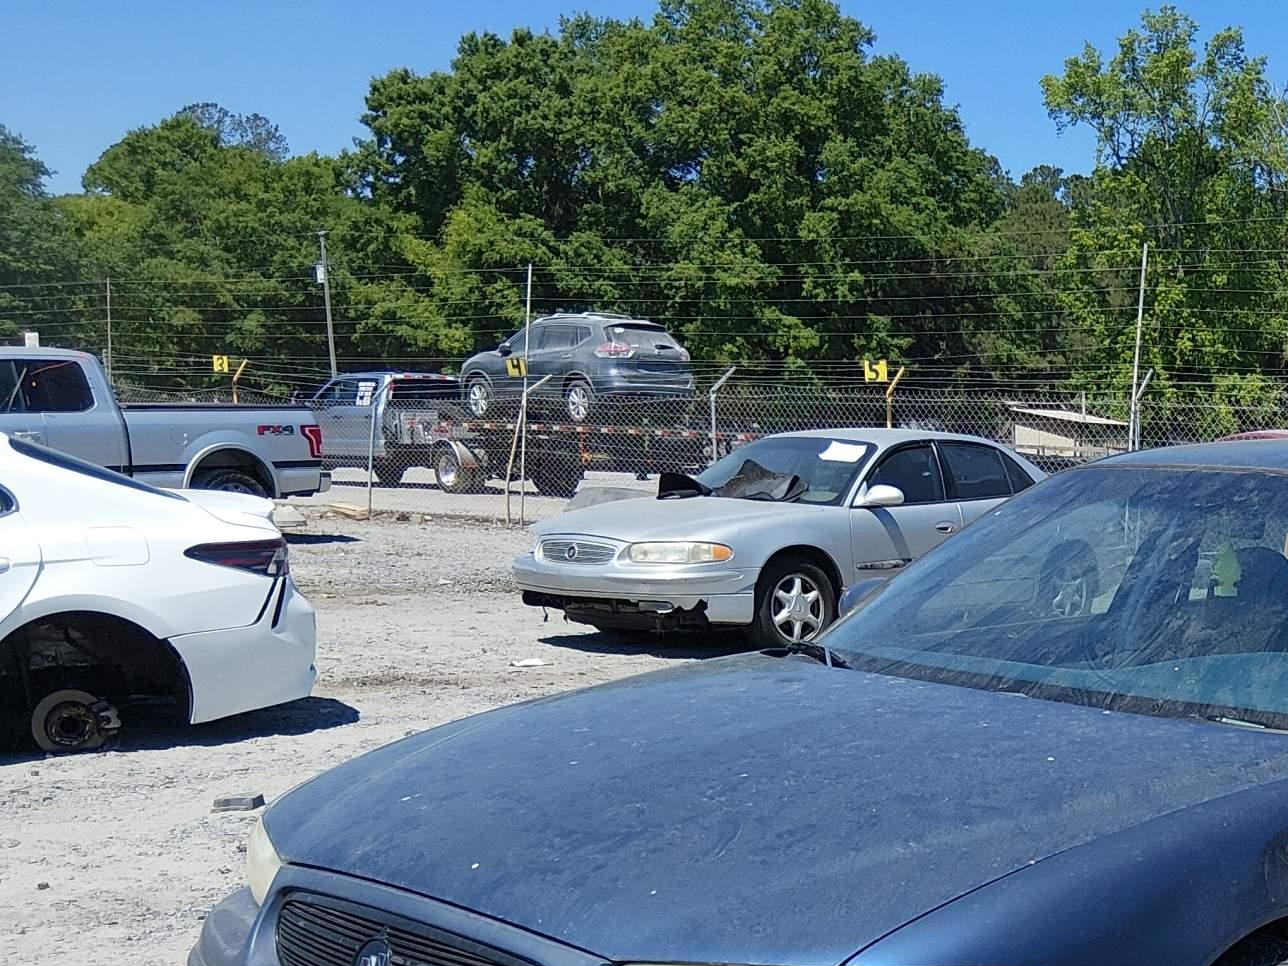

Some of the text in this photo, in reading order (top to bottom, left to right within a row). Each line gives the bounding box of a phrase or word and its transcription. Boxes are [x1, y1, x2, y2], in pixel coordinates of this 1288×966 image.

[217, 357, 225, 371] 3
[509, 358, 522, 376] 4
[868, 360, 880, 381] 5
[257, 425, 294, 435] FX4
